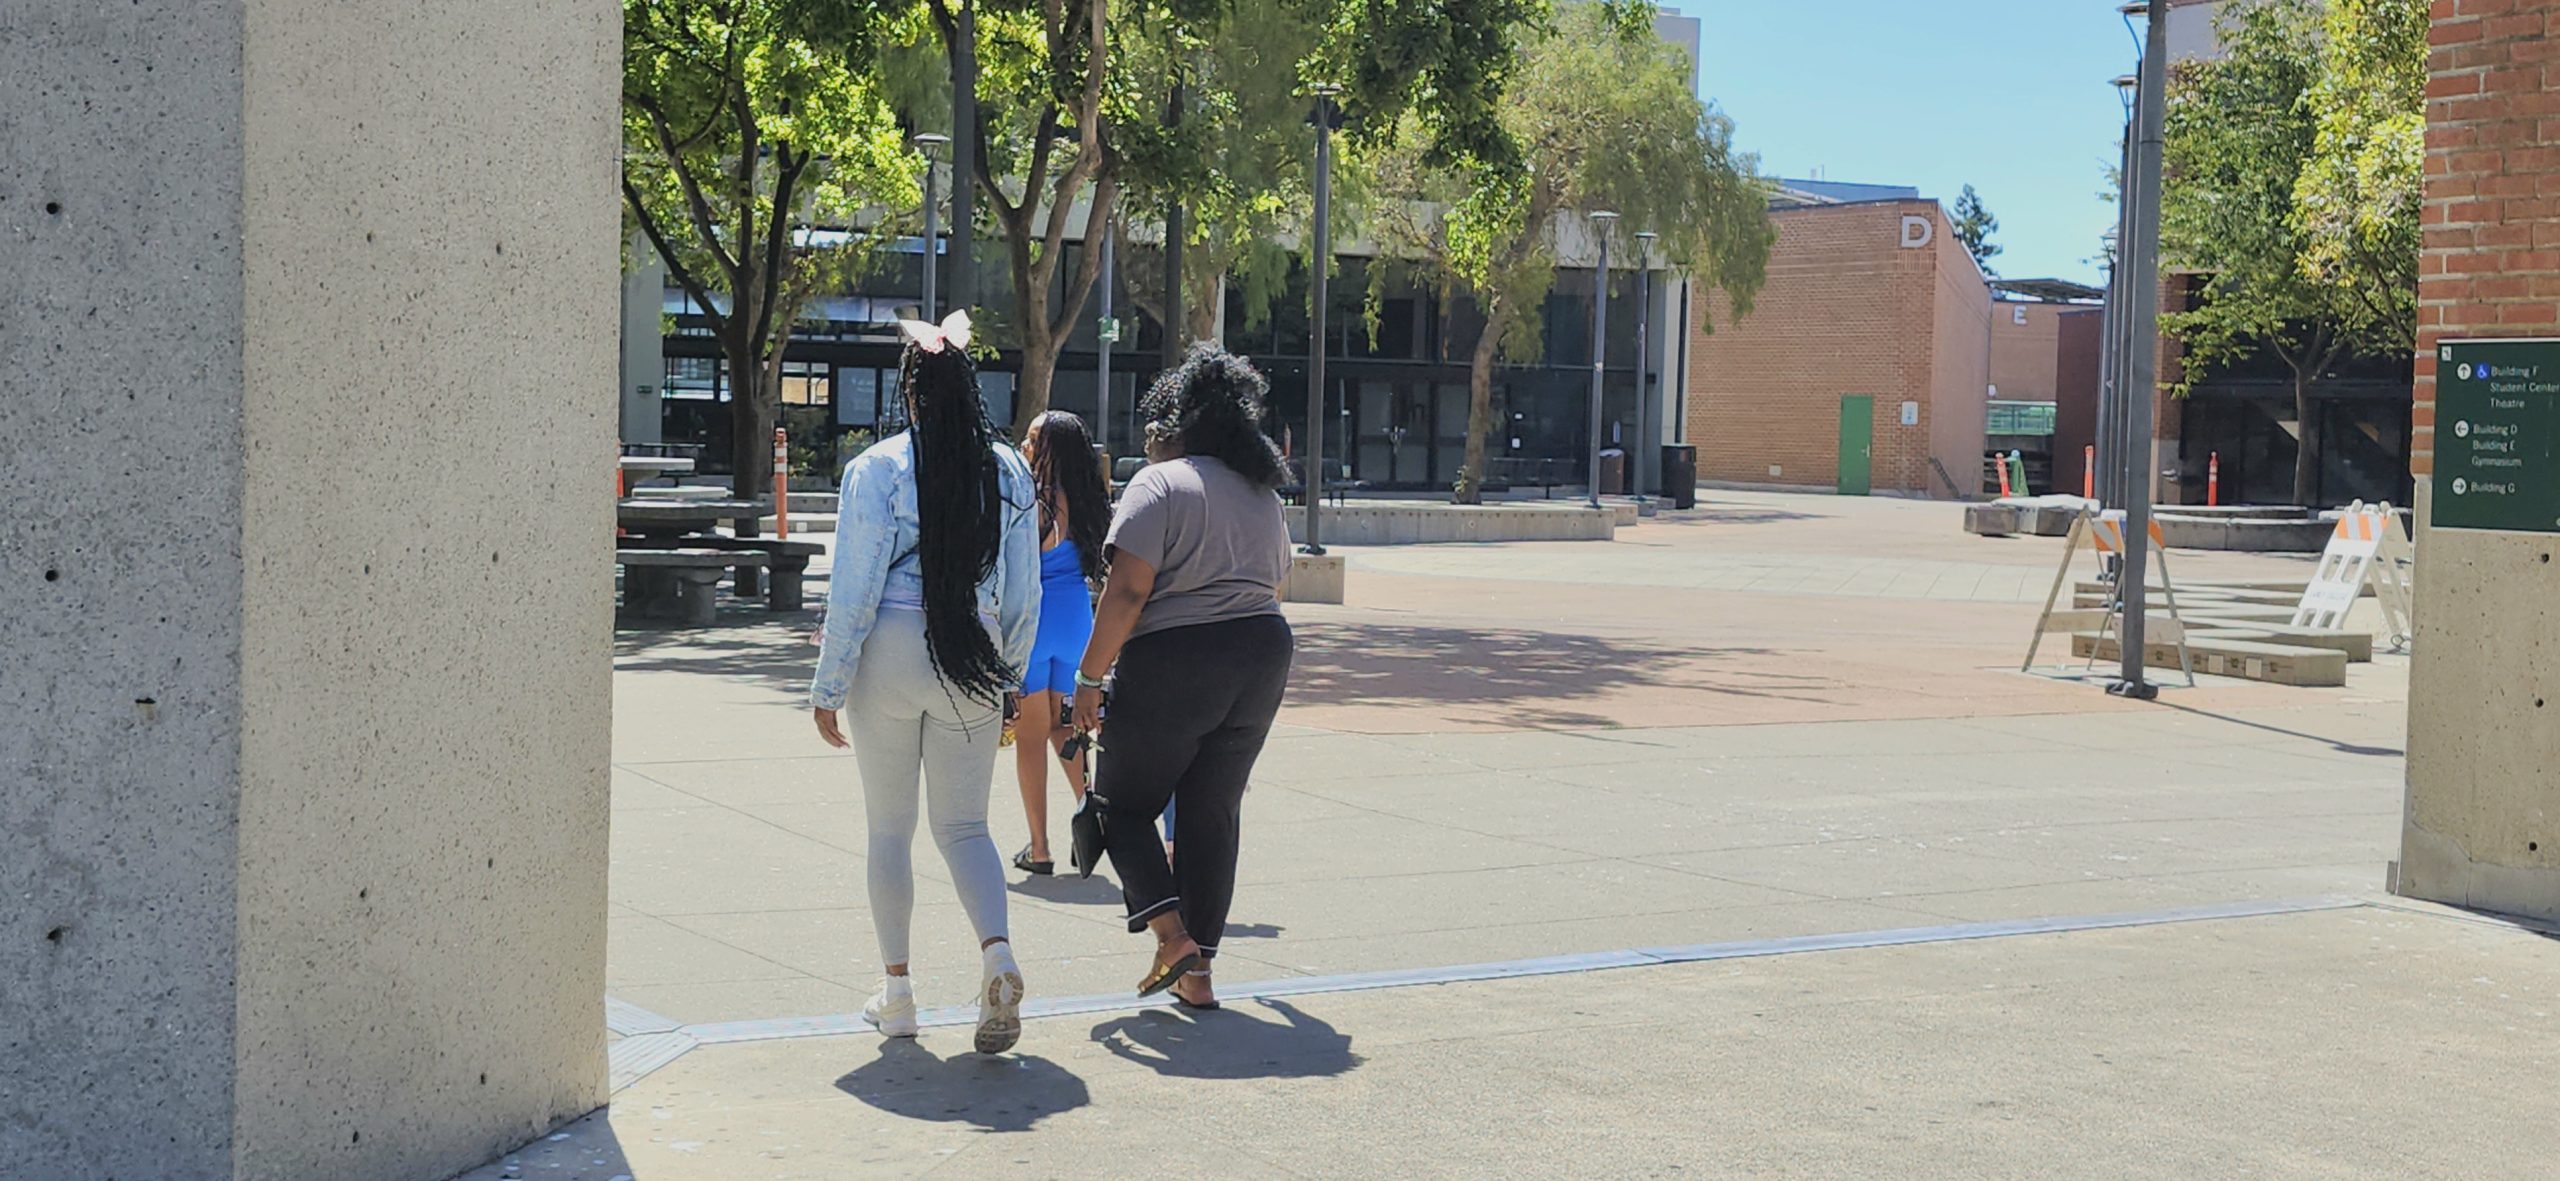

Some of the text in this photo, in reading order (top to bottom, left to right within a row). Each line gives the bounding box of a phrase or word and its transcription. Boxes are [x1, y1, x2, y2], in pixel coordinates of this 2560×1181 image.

[1901, 215, 1933, 248] D
[2014, 304, 2027, 325] E
[2491, 365, 2530, 379] Building
[2490, 382, 2560, 393] Student Center
[2490, 397, 2525, 409] Theatre
[2473, 423, 2518, 436] Building D
[2473, 439, 2508, 453] Building
[2471, 455, 2522, 468] Gymnasium
[2470, 481, 2515, 495] Building G
